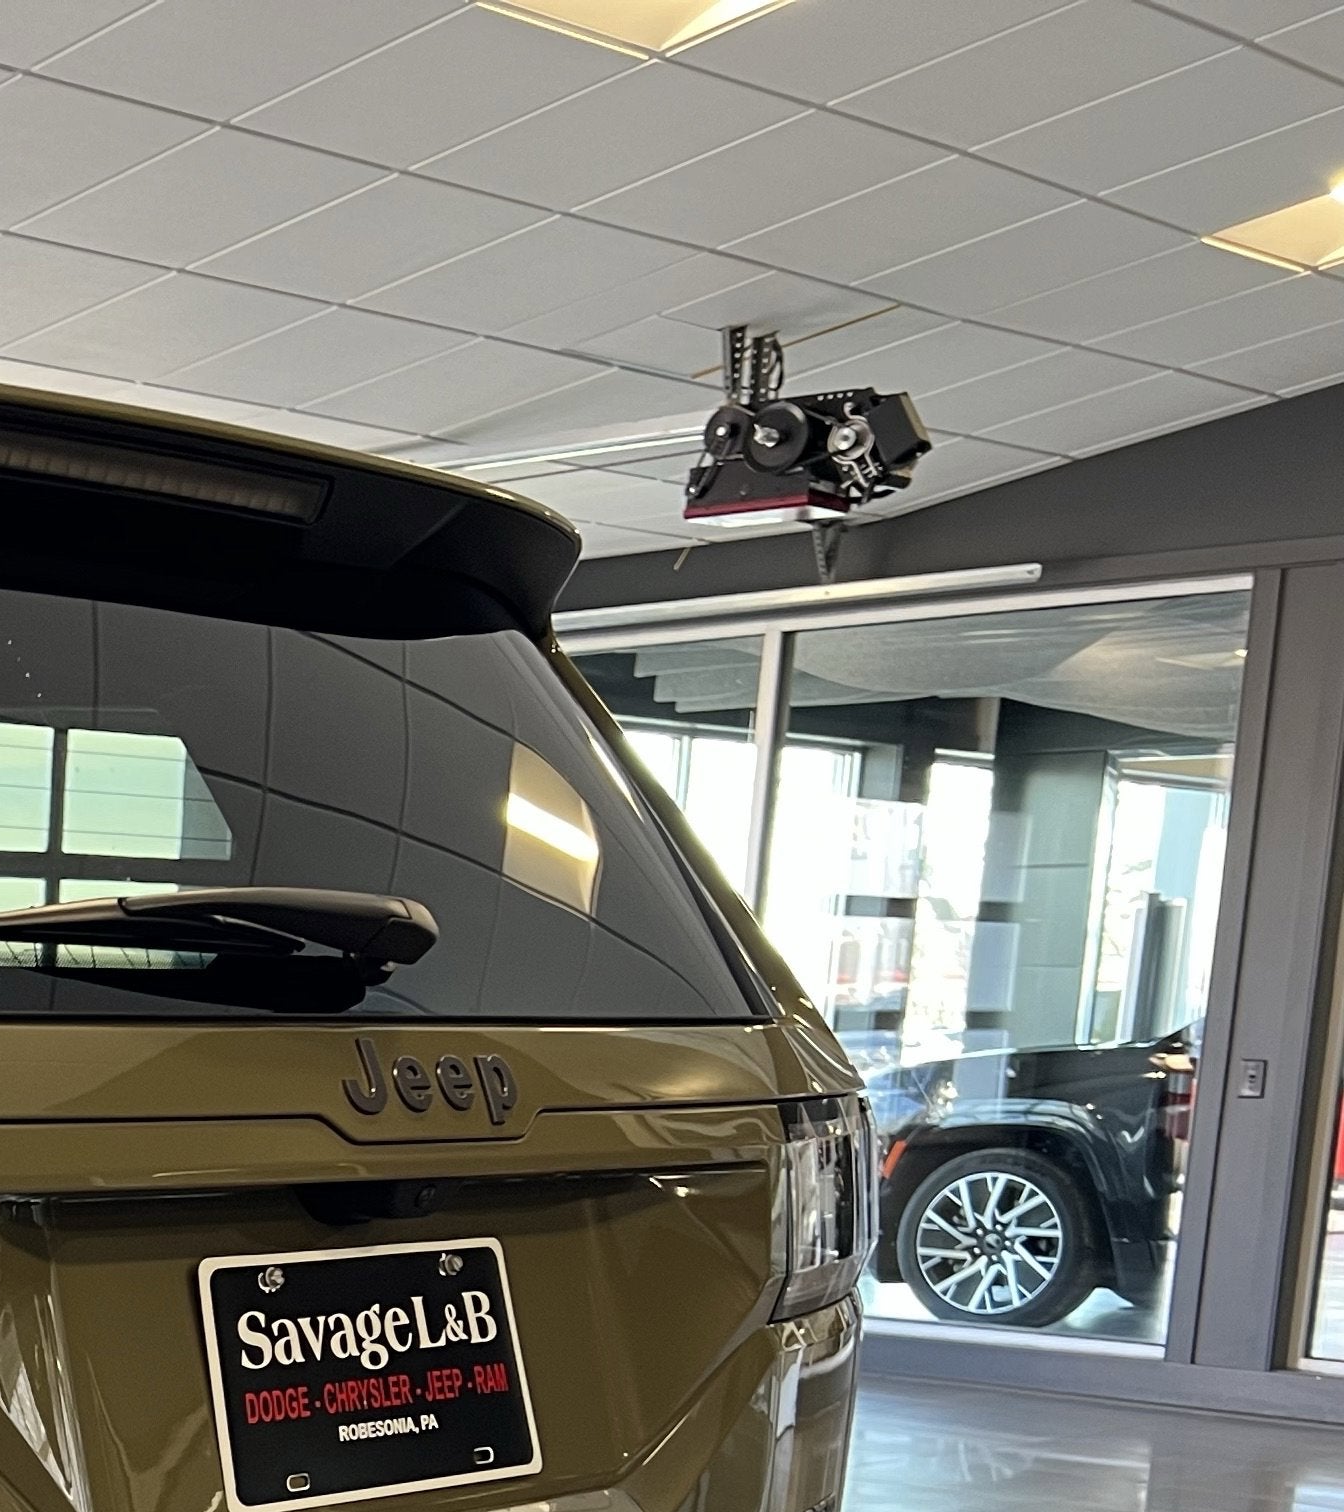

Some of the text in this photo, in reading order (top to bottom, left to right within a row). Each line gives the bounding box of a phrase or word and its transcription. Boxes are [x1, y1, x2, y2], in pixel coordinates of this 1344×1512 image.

[341, 1037, 518, 1126] Jeep
[244, 1362, 509, 1425] DODGE CHRYSLER JEEP RAM
[338, 1413, 439, 1442] ROBESONIA, PA
